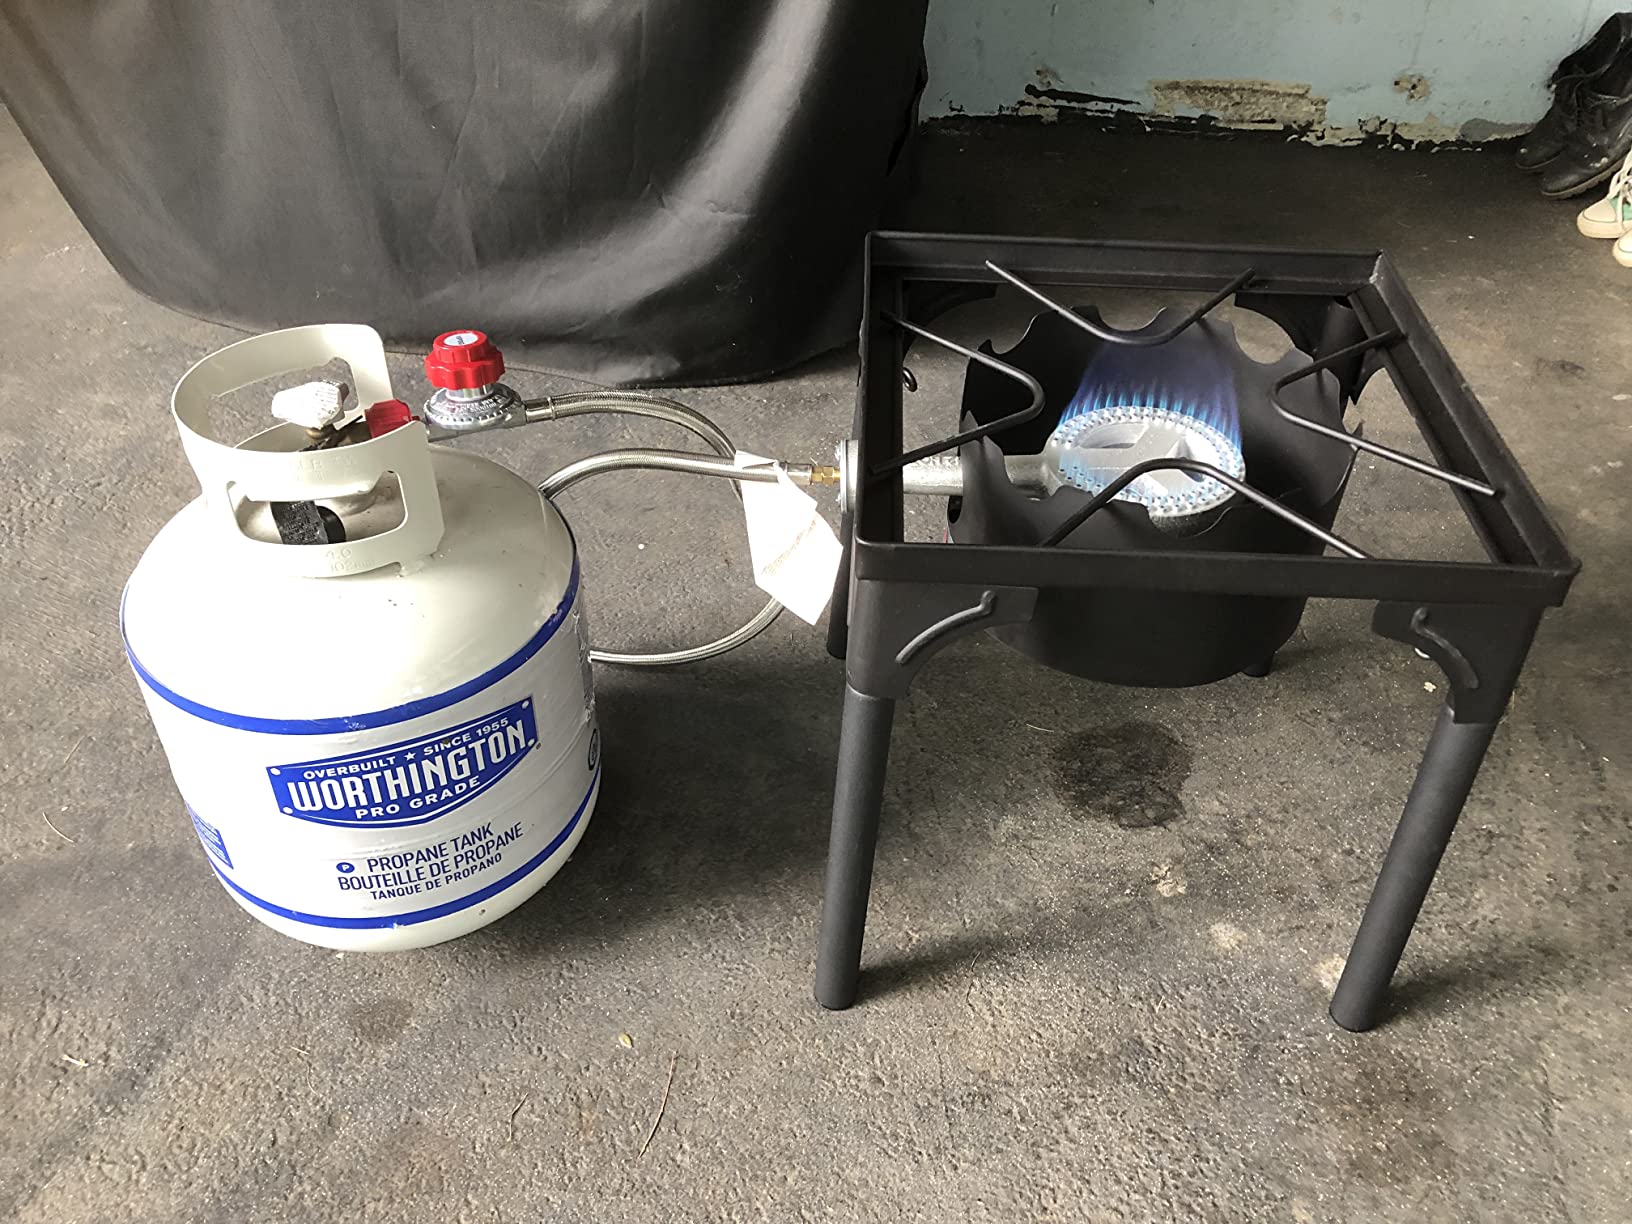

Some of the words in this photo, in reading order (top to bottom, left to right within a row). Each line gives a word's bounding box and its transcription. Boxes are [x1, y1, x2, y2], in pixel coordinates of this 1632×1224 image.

[286, 719, 526, 812] WORTHINGTON
[303, 756, 396, 780] OVERBUILT
[423, 733, 472, 756] SINCE
[475, 717, 509, 736] 1955
[355, 803, 401, 819] PRO
[409, 775, 481, 809] GRADE
[337, 866, 427, 891] BOUTEILLE
[429, 858, 452, 880] DE
[453, 820, 524, 869] PROPANE
[367, 841, 449, 873] PROPANE
[450, 821, 494, 851] TANK
[370, 882, 423, 900] TANQUE
[425, 877, 443, 891] DE
[445, 851, 503, 885] PROPANO
